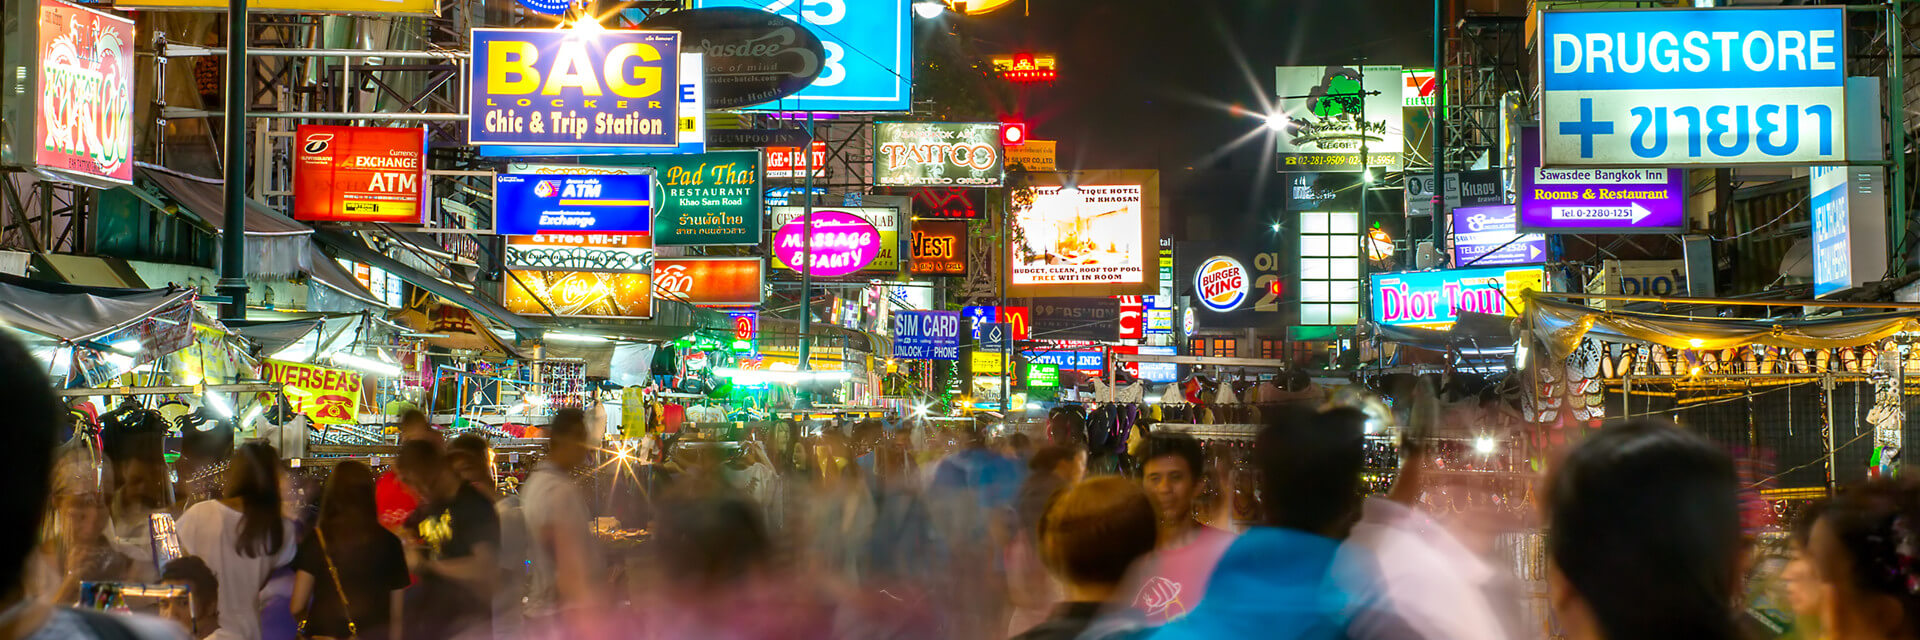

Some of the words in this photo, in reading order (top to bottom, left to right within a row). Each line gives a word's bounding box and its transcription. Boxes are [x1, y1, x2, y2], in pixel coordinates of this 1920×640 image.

[1553, 30, 1836, 73] DRUGSTORE
[487, 40, 662, 98] BAG
[729, 63, 742, 72] of
[747, 63, 778, 72] mind
[748, 87, 782, 102] Hotels
[487, 98, 662, 108] LOCKER
[486, 109, 523, 133] Chic
[529, 110, 545, 133] &
[551, 110, 588, 139] Trip
[595, 111, 662, 135] Station
[1630, 104, 1832, 158] ขายยา
[775, 134, 795, 142] INN
[389, 149, 418, 157] Currency
[880, 142, 998, 170] TATTOO
[1349, 156, 1396, 165] 02-1-5954
[356, 156, 417, 168] EXCHANGE
[667, 162, 706, 186] Pad
[711, 162, 755, 185] Thai
[1540, 170, 1590, 180] Sawasdee
[1594, 170, 1641, 182] Bangkok
[1646, 170, 1662, 180] Inn
[368, 173, 417, 193] ATM
[1424, 177, 1457, 193] EC
[1461, 182, 1495, 197] KILROY
[561, 184, 602, 198] ATM
[671, 188, 750, 197] RESTAURANT
[1534, 189, 1578, 199] Rooms
[1583, 189, 1596, 199] &
[1599, 189, 1668, 199] Restaurant
[679, 198, 700, 206] Khao
[722, 197, 742, 206] Road
[539, 214, 596, 228] Exchange
[874, 215, 894, 227] LAB
[532, 234, 544, 243] &
[549, 234, 584, 244] Free
[781, 232, 871, 249] MSSAGE
[1203, 267, 1240, 287] BURGER
[1205, 276, 1241, 299] KING
[1255, 274, 1278, 312] 2
[1381, 281, 1439, 321] Dior
[1442, 280, 1504, 318] Tour
[896, 314, 918, 336] SIM
[923, 315, 958, 337] CARD
[895, 345, 922, 357] UNLOCK
[934, 346, 957, 358] PHONE
[261, 362, 360, 392] OVERSEAS
